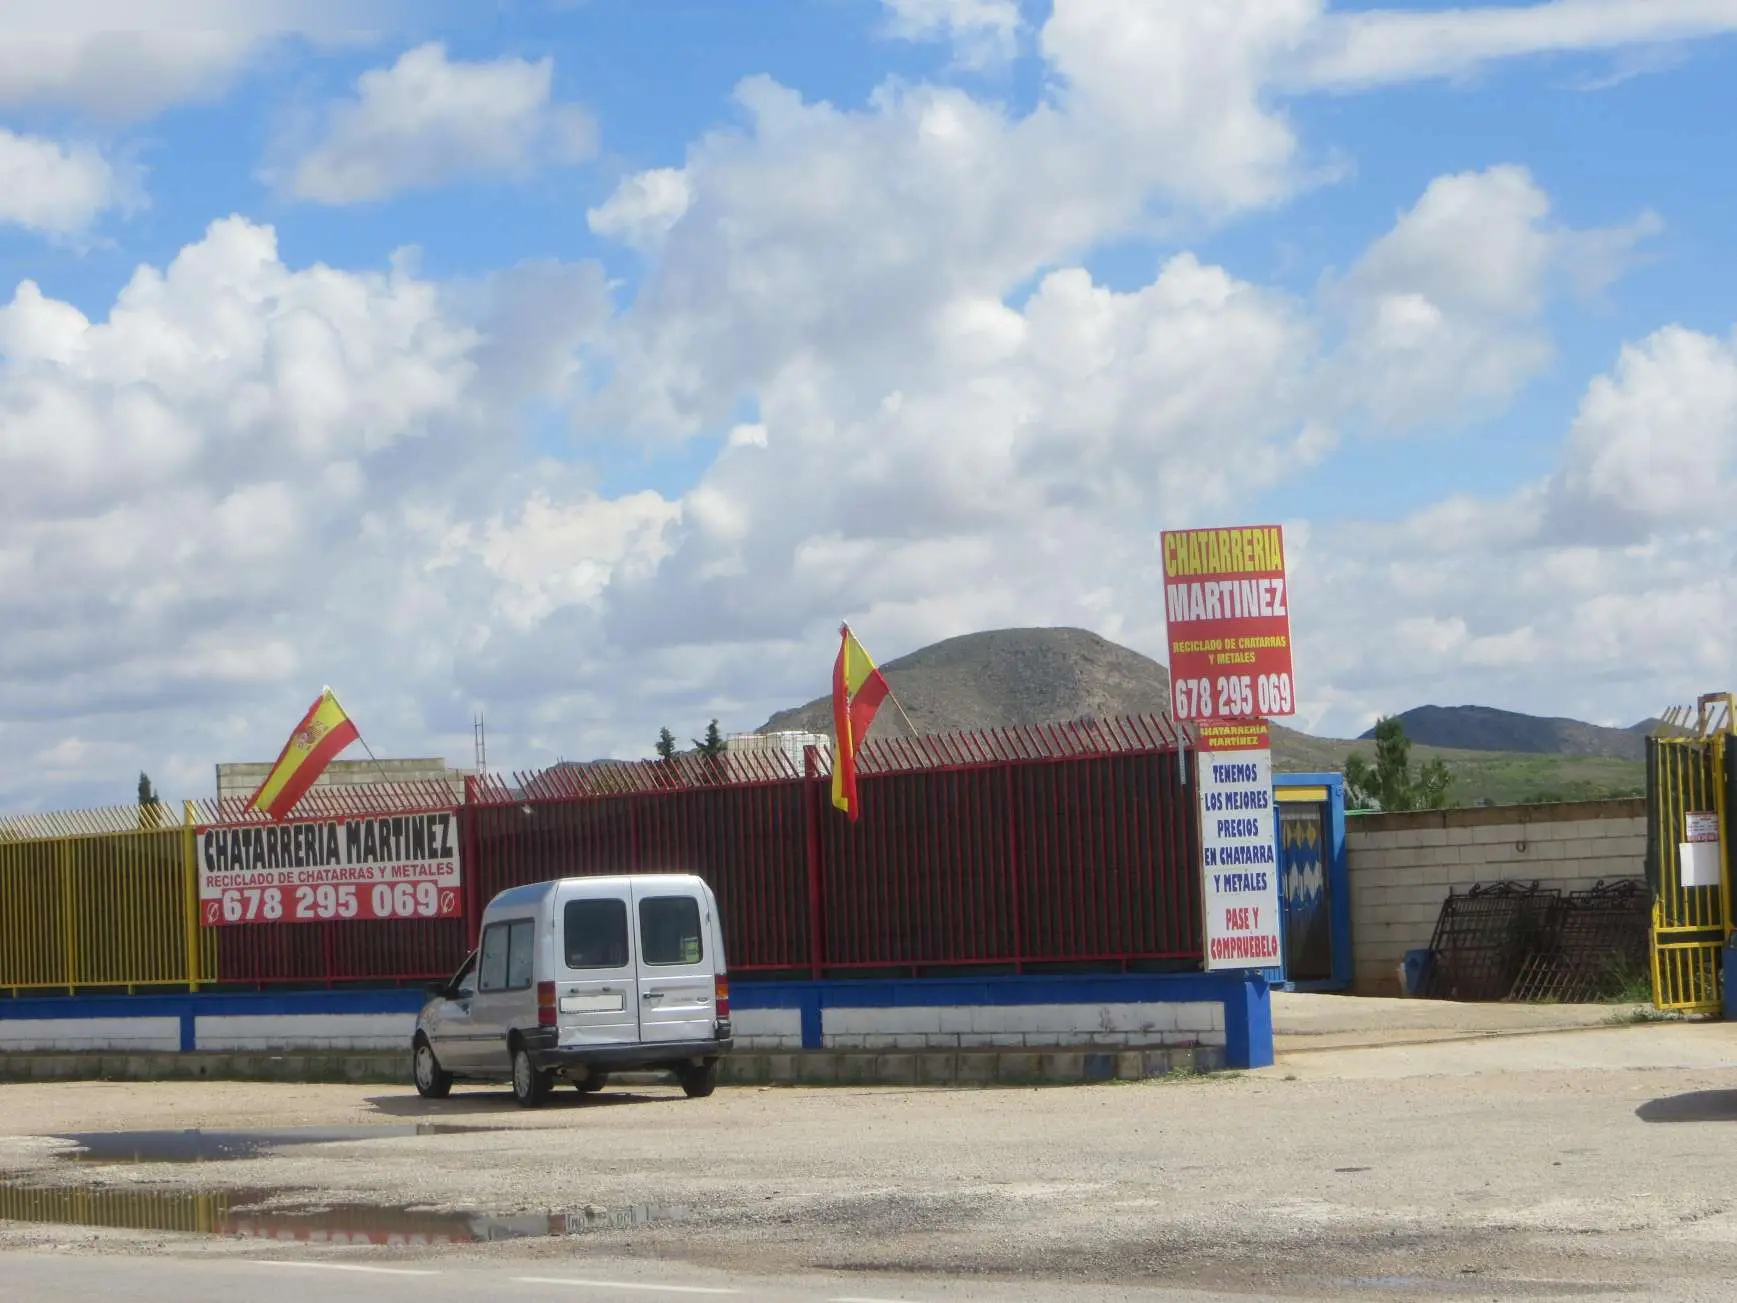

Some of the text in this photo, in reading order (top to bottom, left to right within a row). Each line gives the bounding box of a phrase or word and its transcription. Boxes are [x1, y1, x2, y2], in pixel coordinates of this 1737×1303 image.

[1164, 528, 1282, 577] CHATARRERIA
[1167, 578, 1286, 622] MARTINEZ
[1173, 635, 1287, 653] RECICLADO DE CHATARRAS
[1208, 651, 1256, 665] Y METALES
[1175, 672, 1292, 719] 678 295 069
[1212, 763, 1258, 783] TENEMOS
[1204, 790, 1268, 811] LOS MEJORES
[1217, 818, 1259, 838] PRECIOS
[204, 813, 453, 873] CHATARRERIA MARTINEZ
[1204, 845, 1274, 866] EN CHATARRA
[206, 862, 454, 888] RECICLADO DE CHATARRAS Y METALES
[1213, 872, 1268, 893] Y METALES
[222, 881, 439, 921] 678 295 069
[1225, 906, 1259, 931] PASE Y
